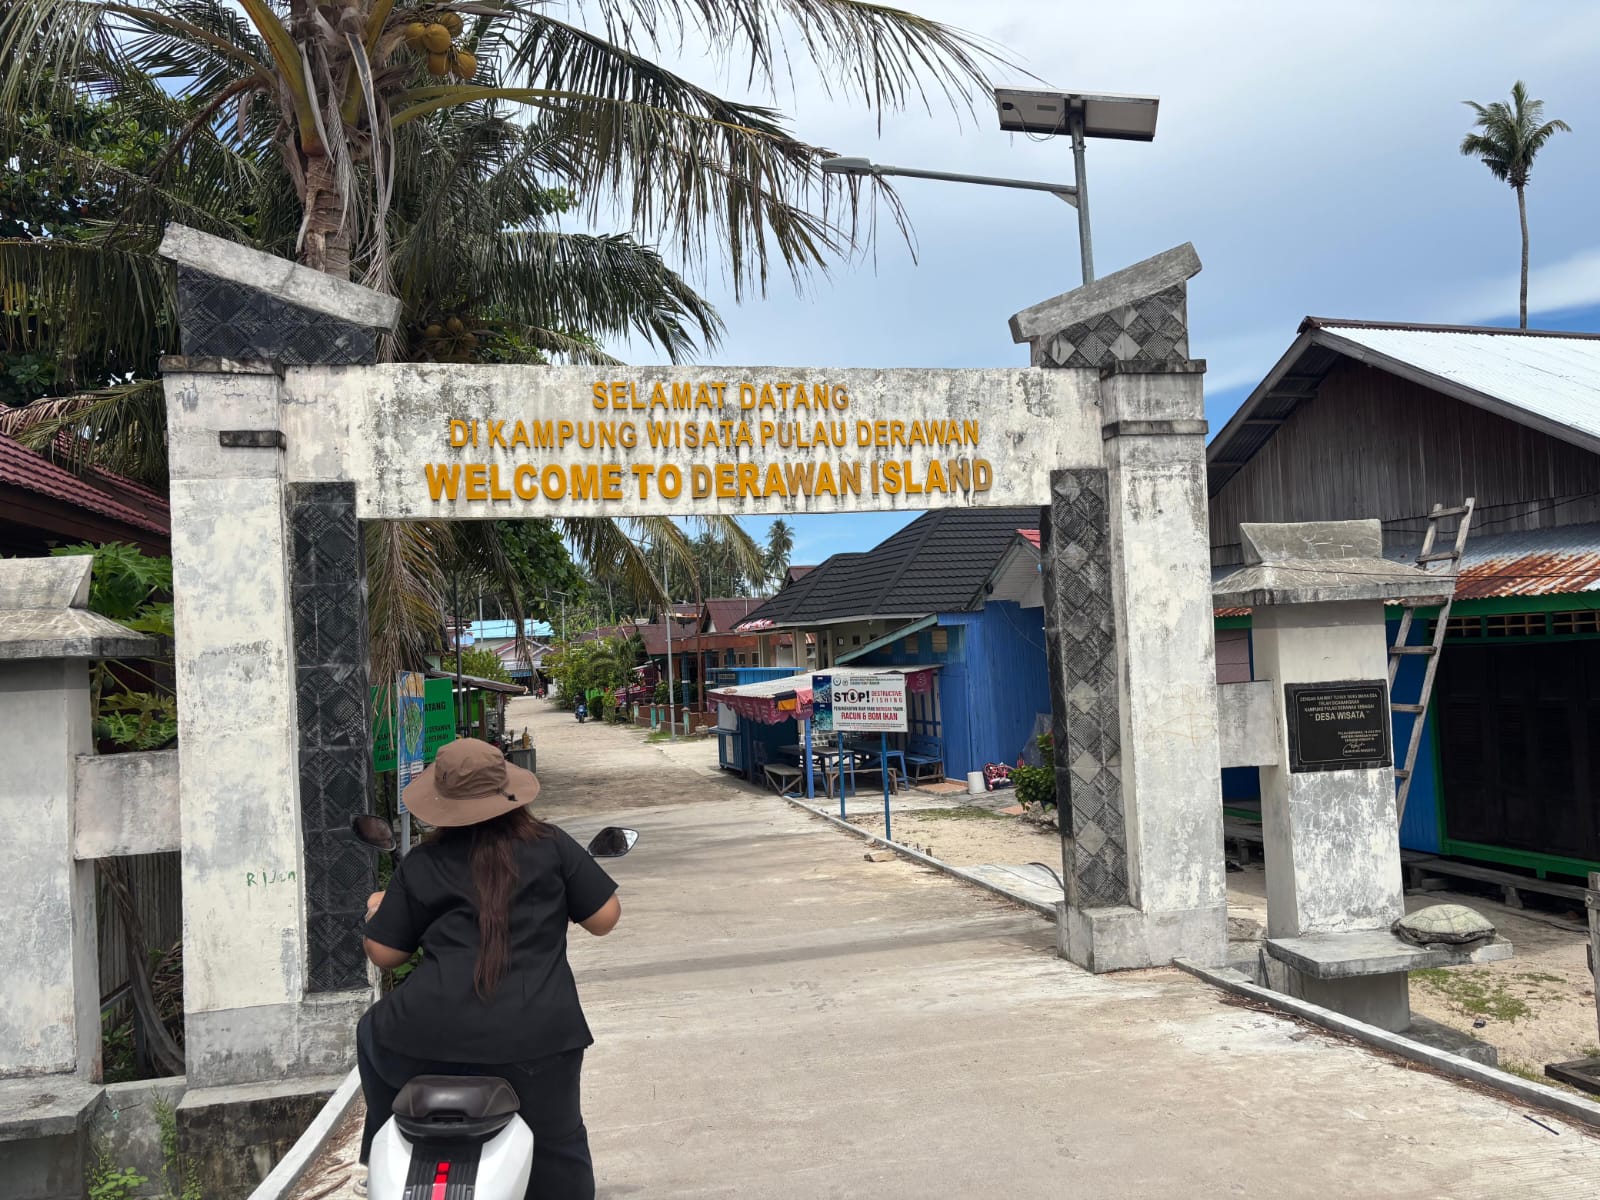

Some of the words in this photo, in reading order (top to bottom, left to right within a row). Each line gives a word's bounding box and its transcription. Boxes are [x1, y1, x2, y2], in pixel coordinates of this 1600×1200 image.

[592, 381, 726, 410] SELAMAT
[739, 383, 849, 410] DATANG
[448, 419, 479, 448] DI
[486, 419, 637, 449] KAMPUNG
[645, 420, 753, 448] WISATA
[759, 421, 846, 448] PULAU
[855, 420, 979, 447] DERAWAN
[424, 464, 624, 501] WELCOME
[630, 464, 683, 500] TO
[690, 462, 862, 499] DERAWAN
[869, 460, 993, 495] ISLAND
[425, 702, 446, 712] ATANG
[841, 712, 861, 720] RACUN
[1315, 712, 1336, 720] DESA
[1337, 711, 1365, 720] WISATA
